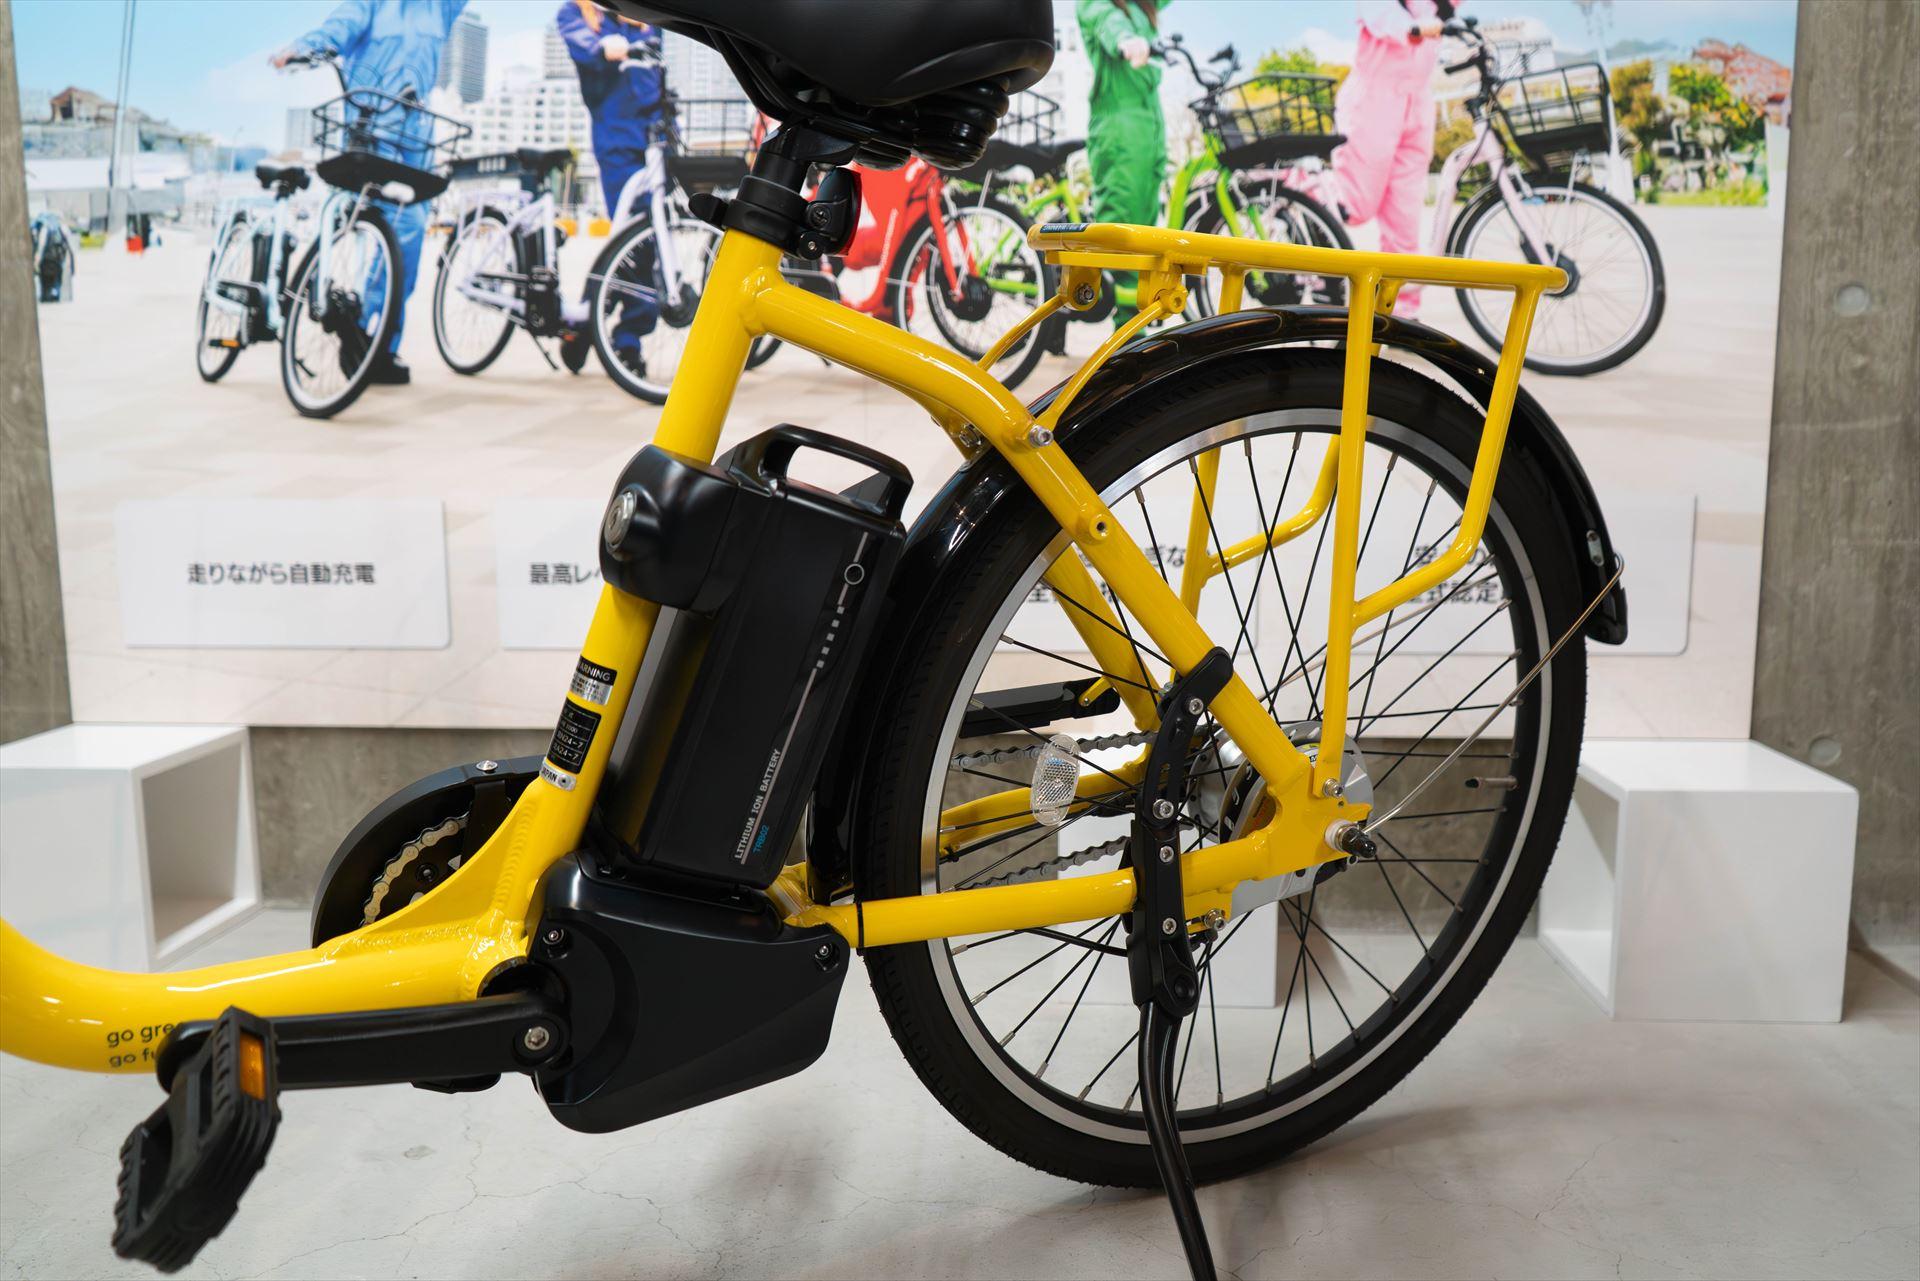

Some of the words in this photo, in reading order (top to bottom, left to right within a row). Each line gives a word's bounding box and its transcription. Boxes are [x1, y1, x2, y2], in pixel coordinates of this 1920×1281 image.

[188, 562, 376, 586] 走りながら自動充電
[530, 562, 601, 585] 最高レ
[735, 817, 755, 859] LITHIUM
[751, 795, 764, 814] ION
[760, 748, 781, 791] BATTERY
[107, 1029, 134, 1048] go
[109, 1053, 136, 1067] go
